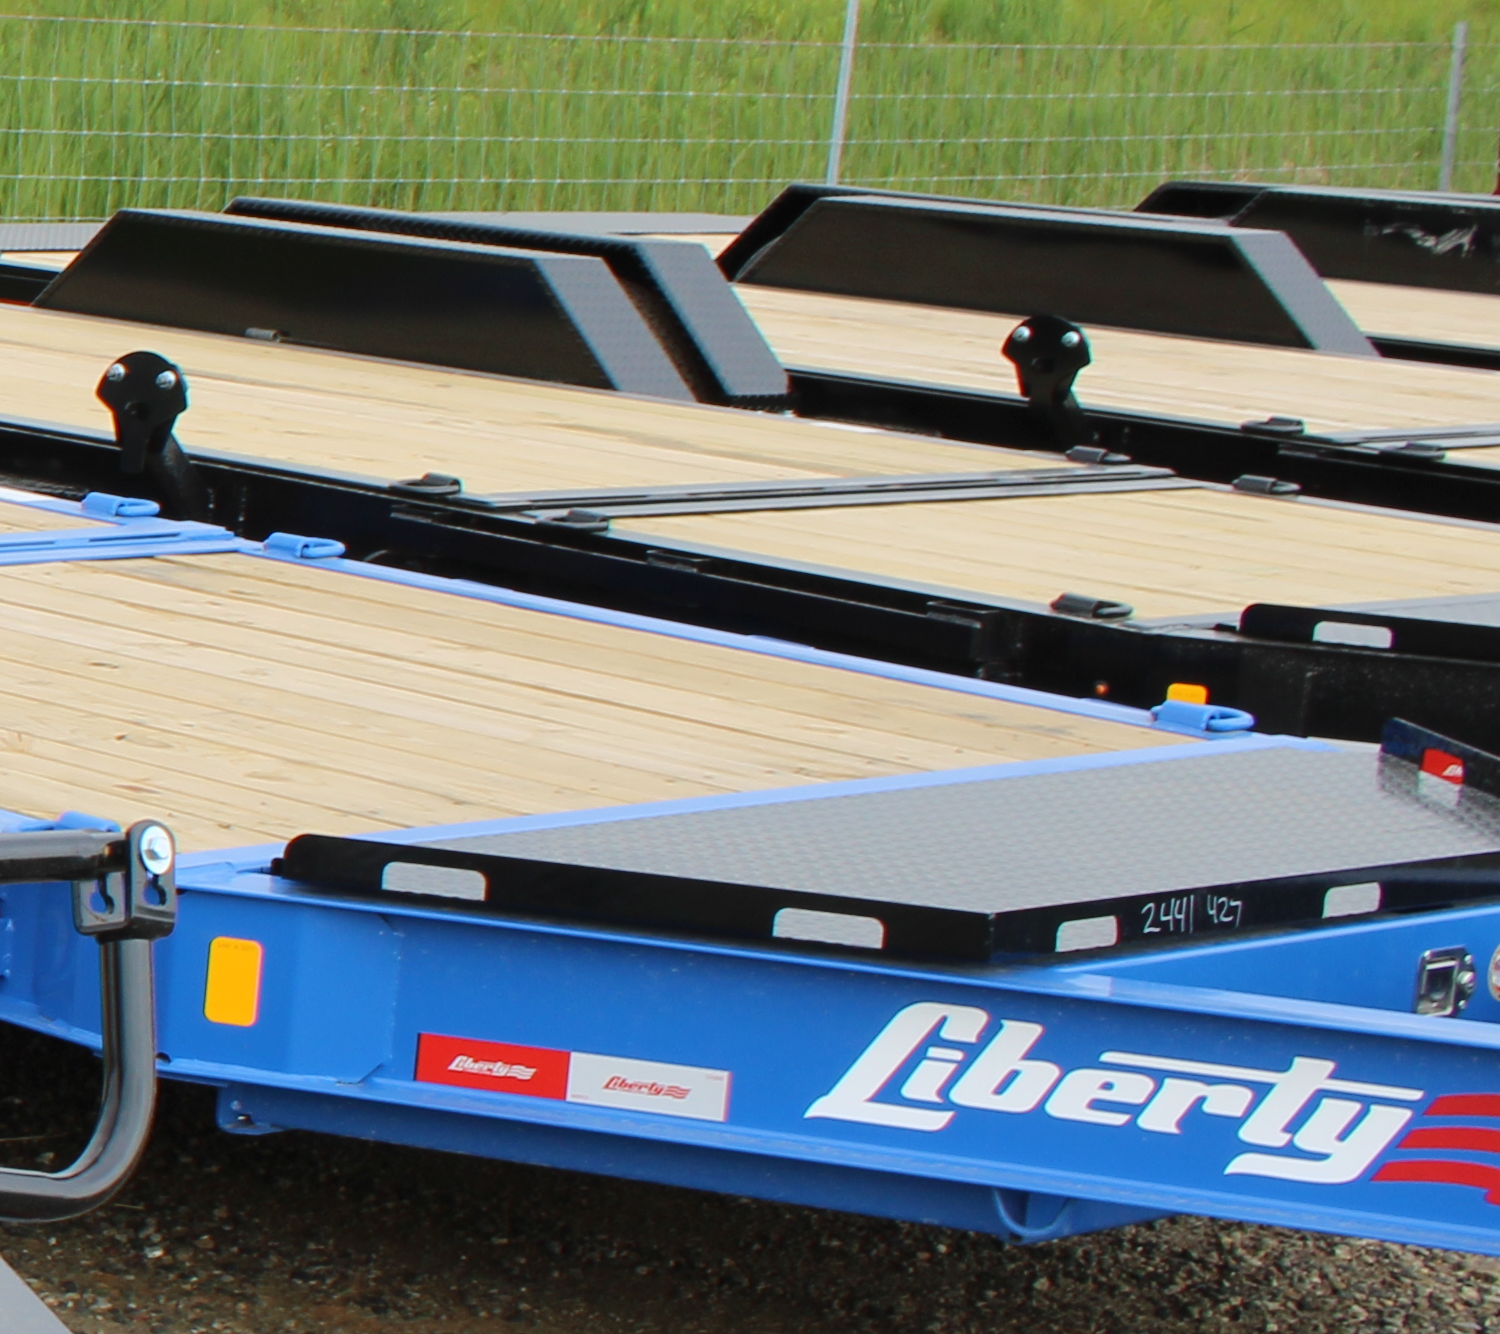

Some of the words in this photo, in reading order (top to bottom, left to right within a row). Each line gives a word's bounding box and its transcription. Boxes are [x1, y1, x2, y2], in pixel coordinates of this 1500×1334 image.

[1141, 894, 1194, 934] 2441
[1207, 894, 1242, 928] 427
[448, 1055, 511, 1077] Liberty
[602, 1075, 666, 1096] Liberty
[803, 1001, 1424, 1184] Liberty
